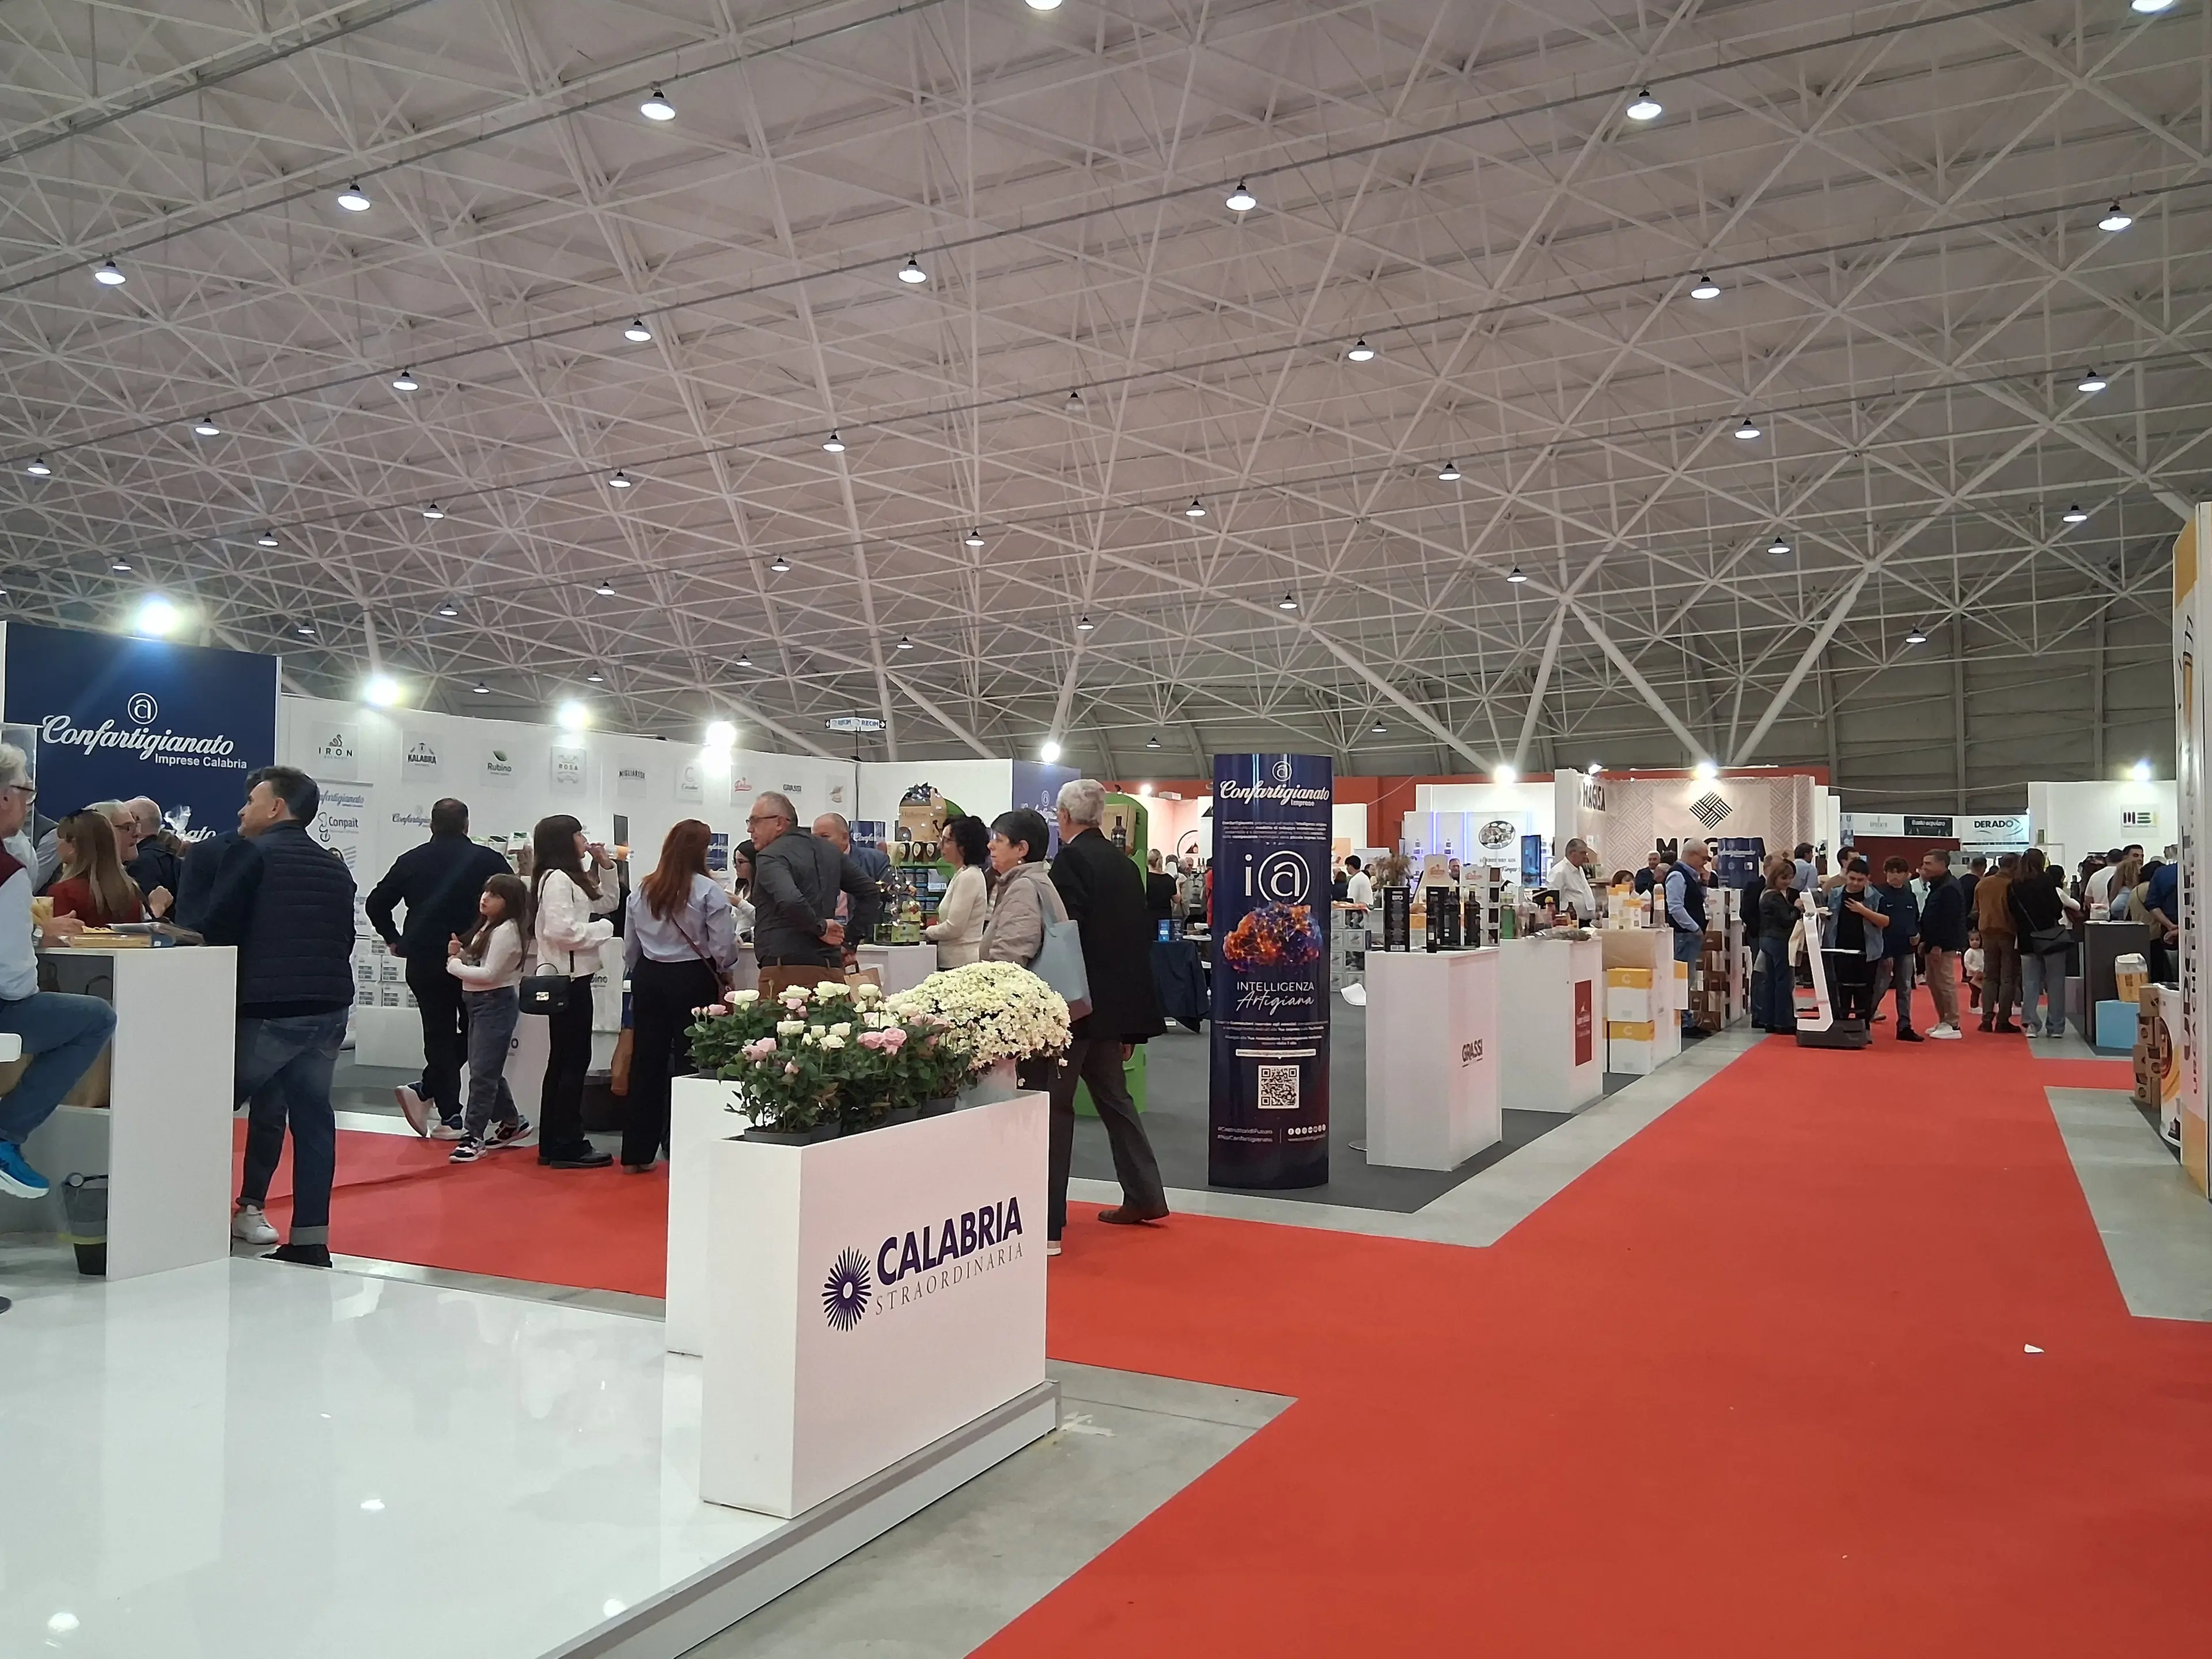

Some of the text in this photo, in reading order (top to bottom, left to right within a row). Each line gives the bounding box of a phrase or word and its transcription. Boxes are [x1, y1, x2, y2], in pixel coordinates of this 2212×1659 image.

[43, 715, 234, 760] Confartigianato
[155, 753, 247, 769] Imprese Calabria
[319, 747, 353, 757] IRON
[487, 763, 512, 772] Rubino
[1220, 780, 1330, 805] Confartigianato
[328, 816, 359, 828] Conpait
[1237, 981, 1315, 991] INTELLIGENZA
[1236, 990, 1315, 1016] Artigiana
[1462, 1039, 1483, 1062] GRASSI
[877, 1196, 1023, 1286] CALABRIA
[875, 1242, 1023, 1315] STRAORDINARIA
